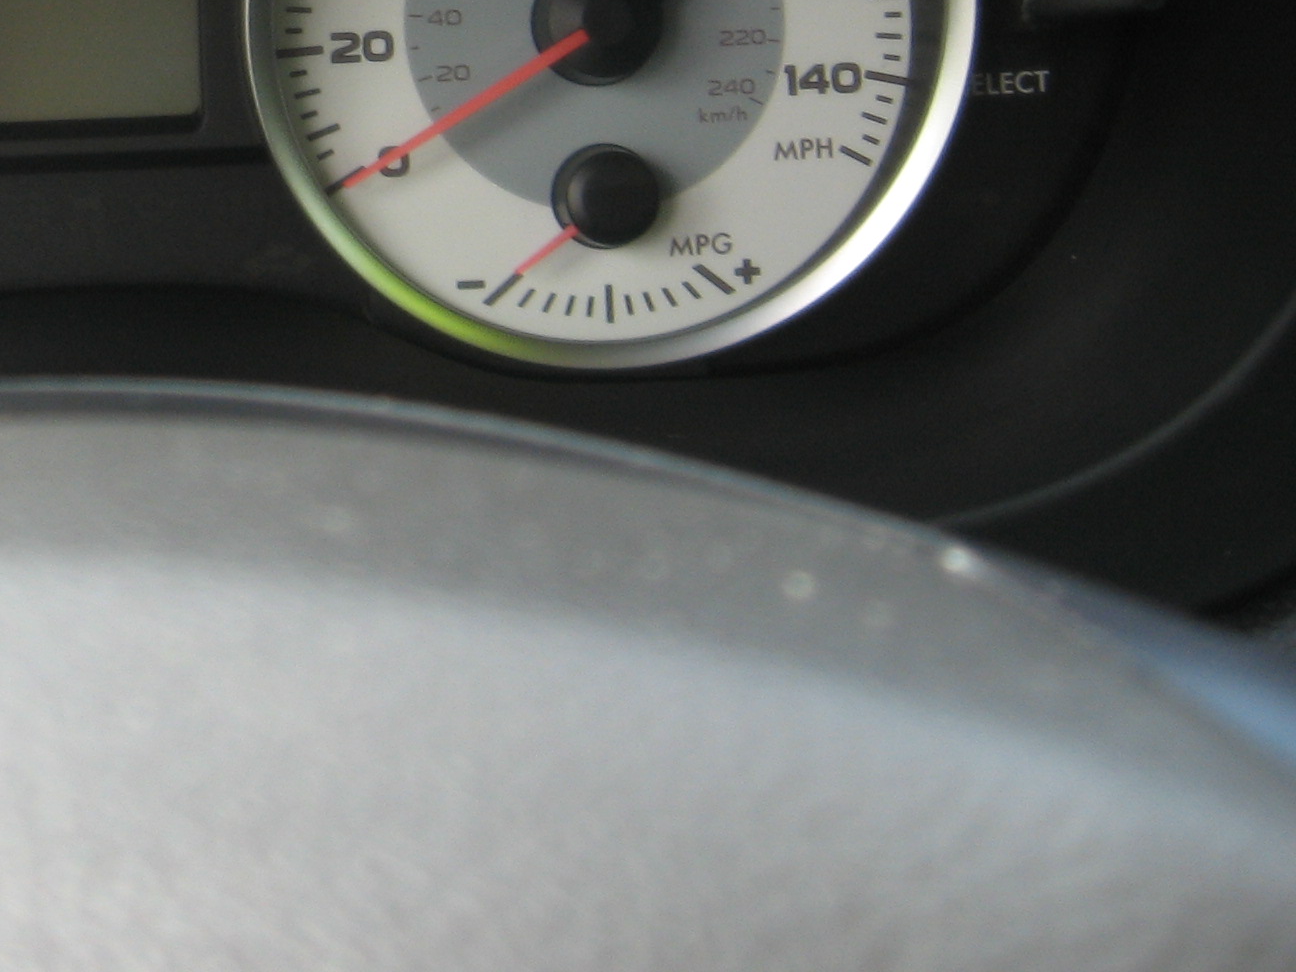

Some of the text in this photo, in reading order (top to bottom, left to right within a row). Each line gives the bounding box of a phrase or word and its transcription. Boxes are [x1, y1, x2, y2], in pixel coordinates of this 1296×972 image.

[427, 9, 463, 26] 40
[330, 30, 394, 64] 20
[718, 30, 767, 47] 220
[436, 64, 471, 82] 20
[784, 62, 862, 96] 140
[708, 79, 754, 96] 240
[698, 105, 748, 124] km/h
[774, 137, 833, 161] MPH
[378, 145, 410, 178] 0
[669, 232, 732, 257] MPG
